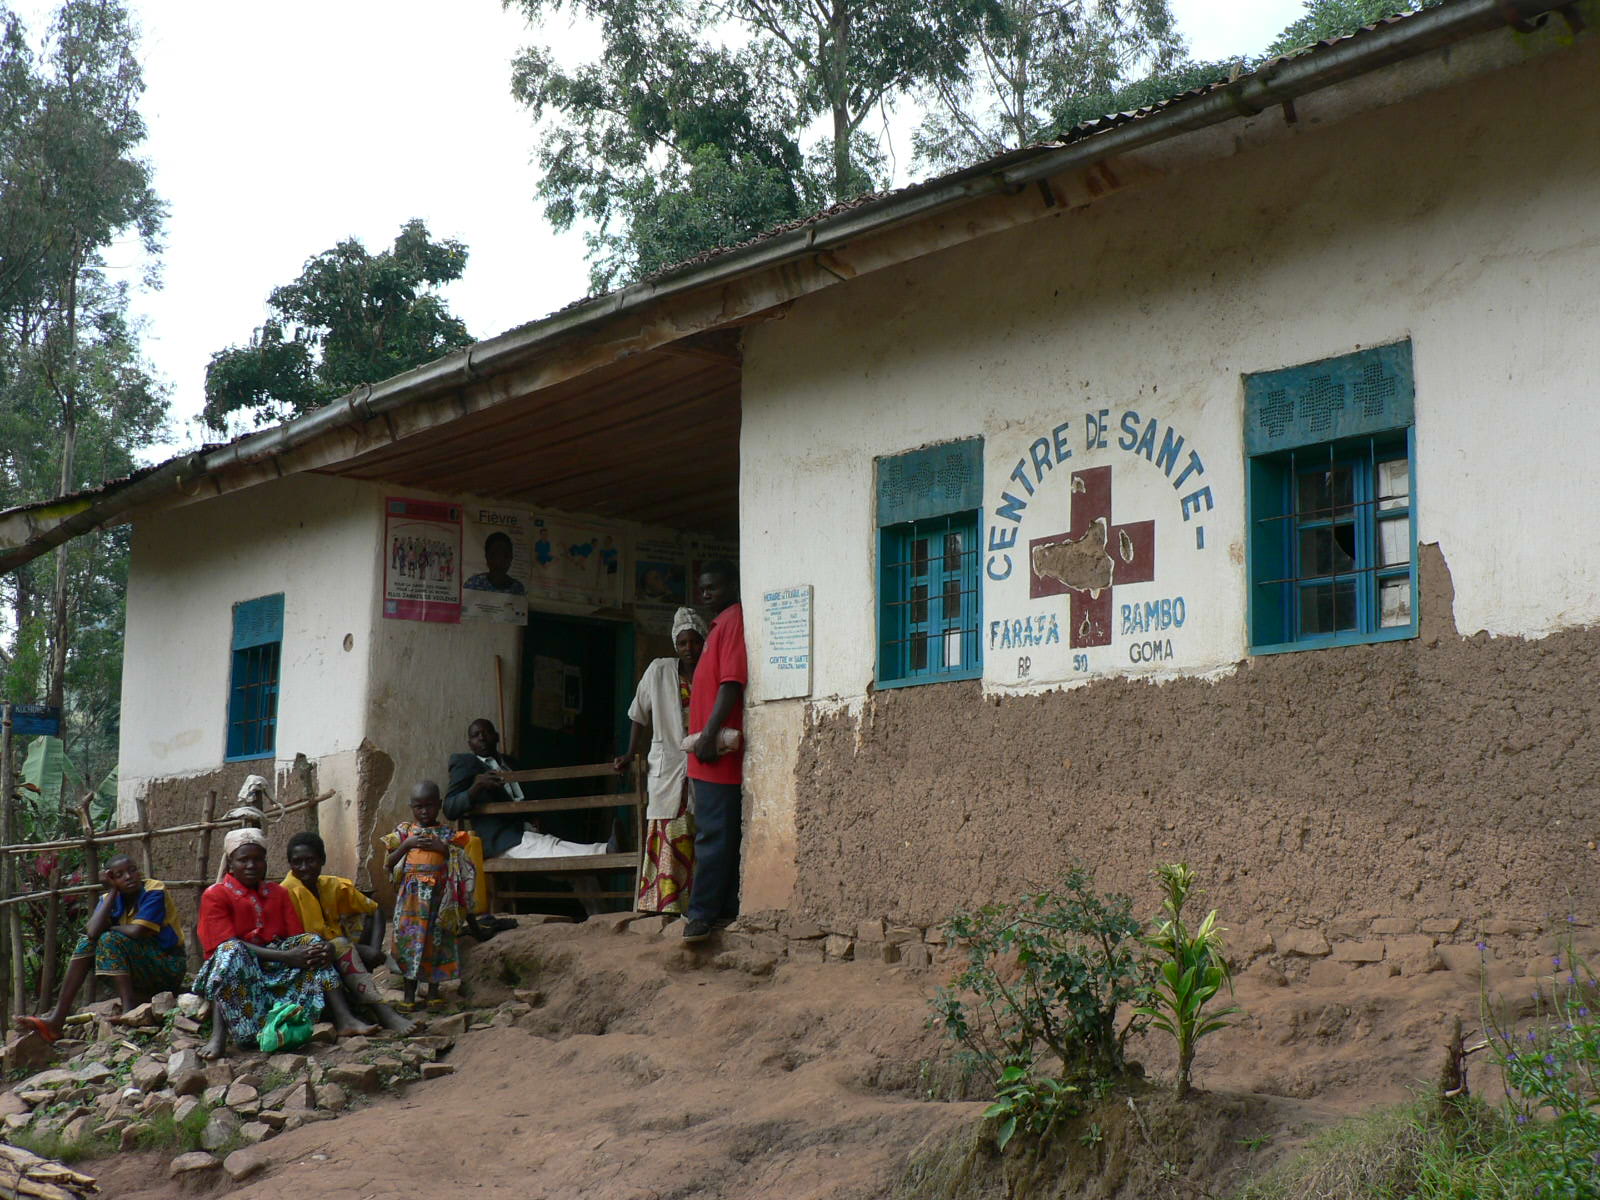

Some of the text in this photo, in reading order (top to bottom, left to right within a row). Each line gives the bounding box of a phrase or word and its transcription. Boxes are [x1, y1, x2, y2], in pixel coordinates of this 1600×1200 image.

[987, 422, 1072, 581] CENTRE
[1085, 408, 1109, 451] DE
[990, 595, 1186, 649] FARAJA BAMBO
[1129, 641, 1174, 663] GOMA
